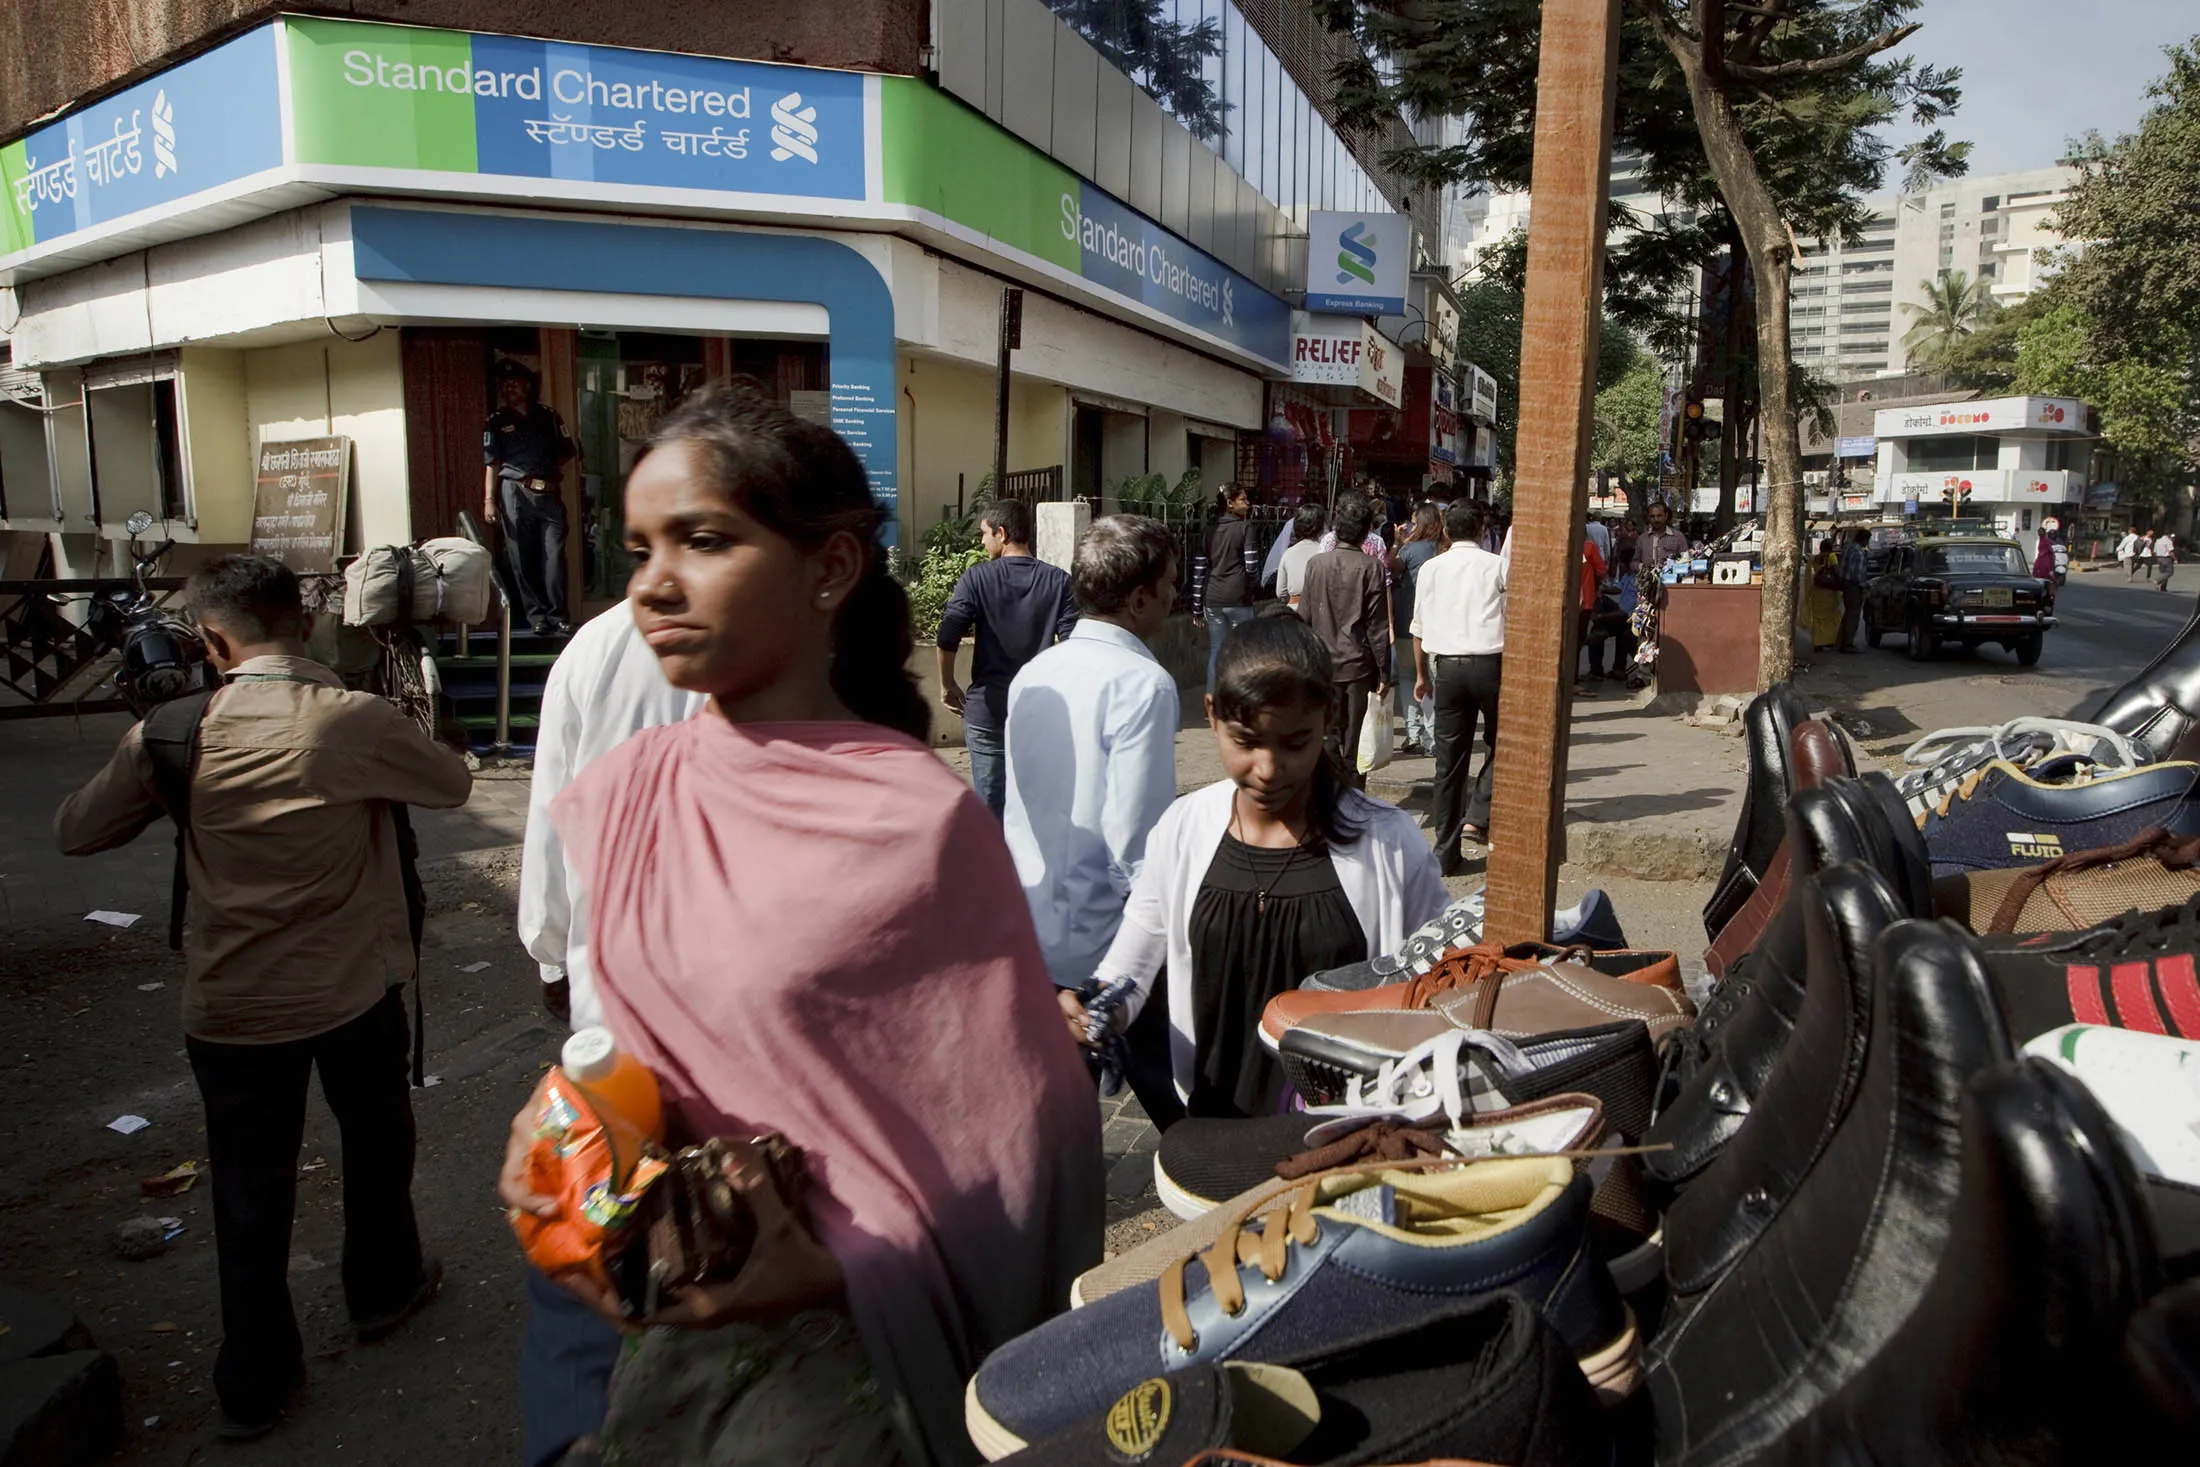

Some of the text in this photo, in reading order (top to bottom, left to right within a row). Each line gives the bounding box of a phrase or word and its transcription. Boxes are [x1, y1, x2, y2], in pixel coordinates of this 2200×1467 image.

[343, 50, 751, 119] Standard Chartered
[1061, 193, 1219, 313] Standard Chartered
[1325, 299, 1384, 310] Express Banking
[1295, 337, 1362, 365] RELIEF
[852, 441, 872, 449] Banking
[2011, 843, 2063, 858] FLUID
